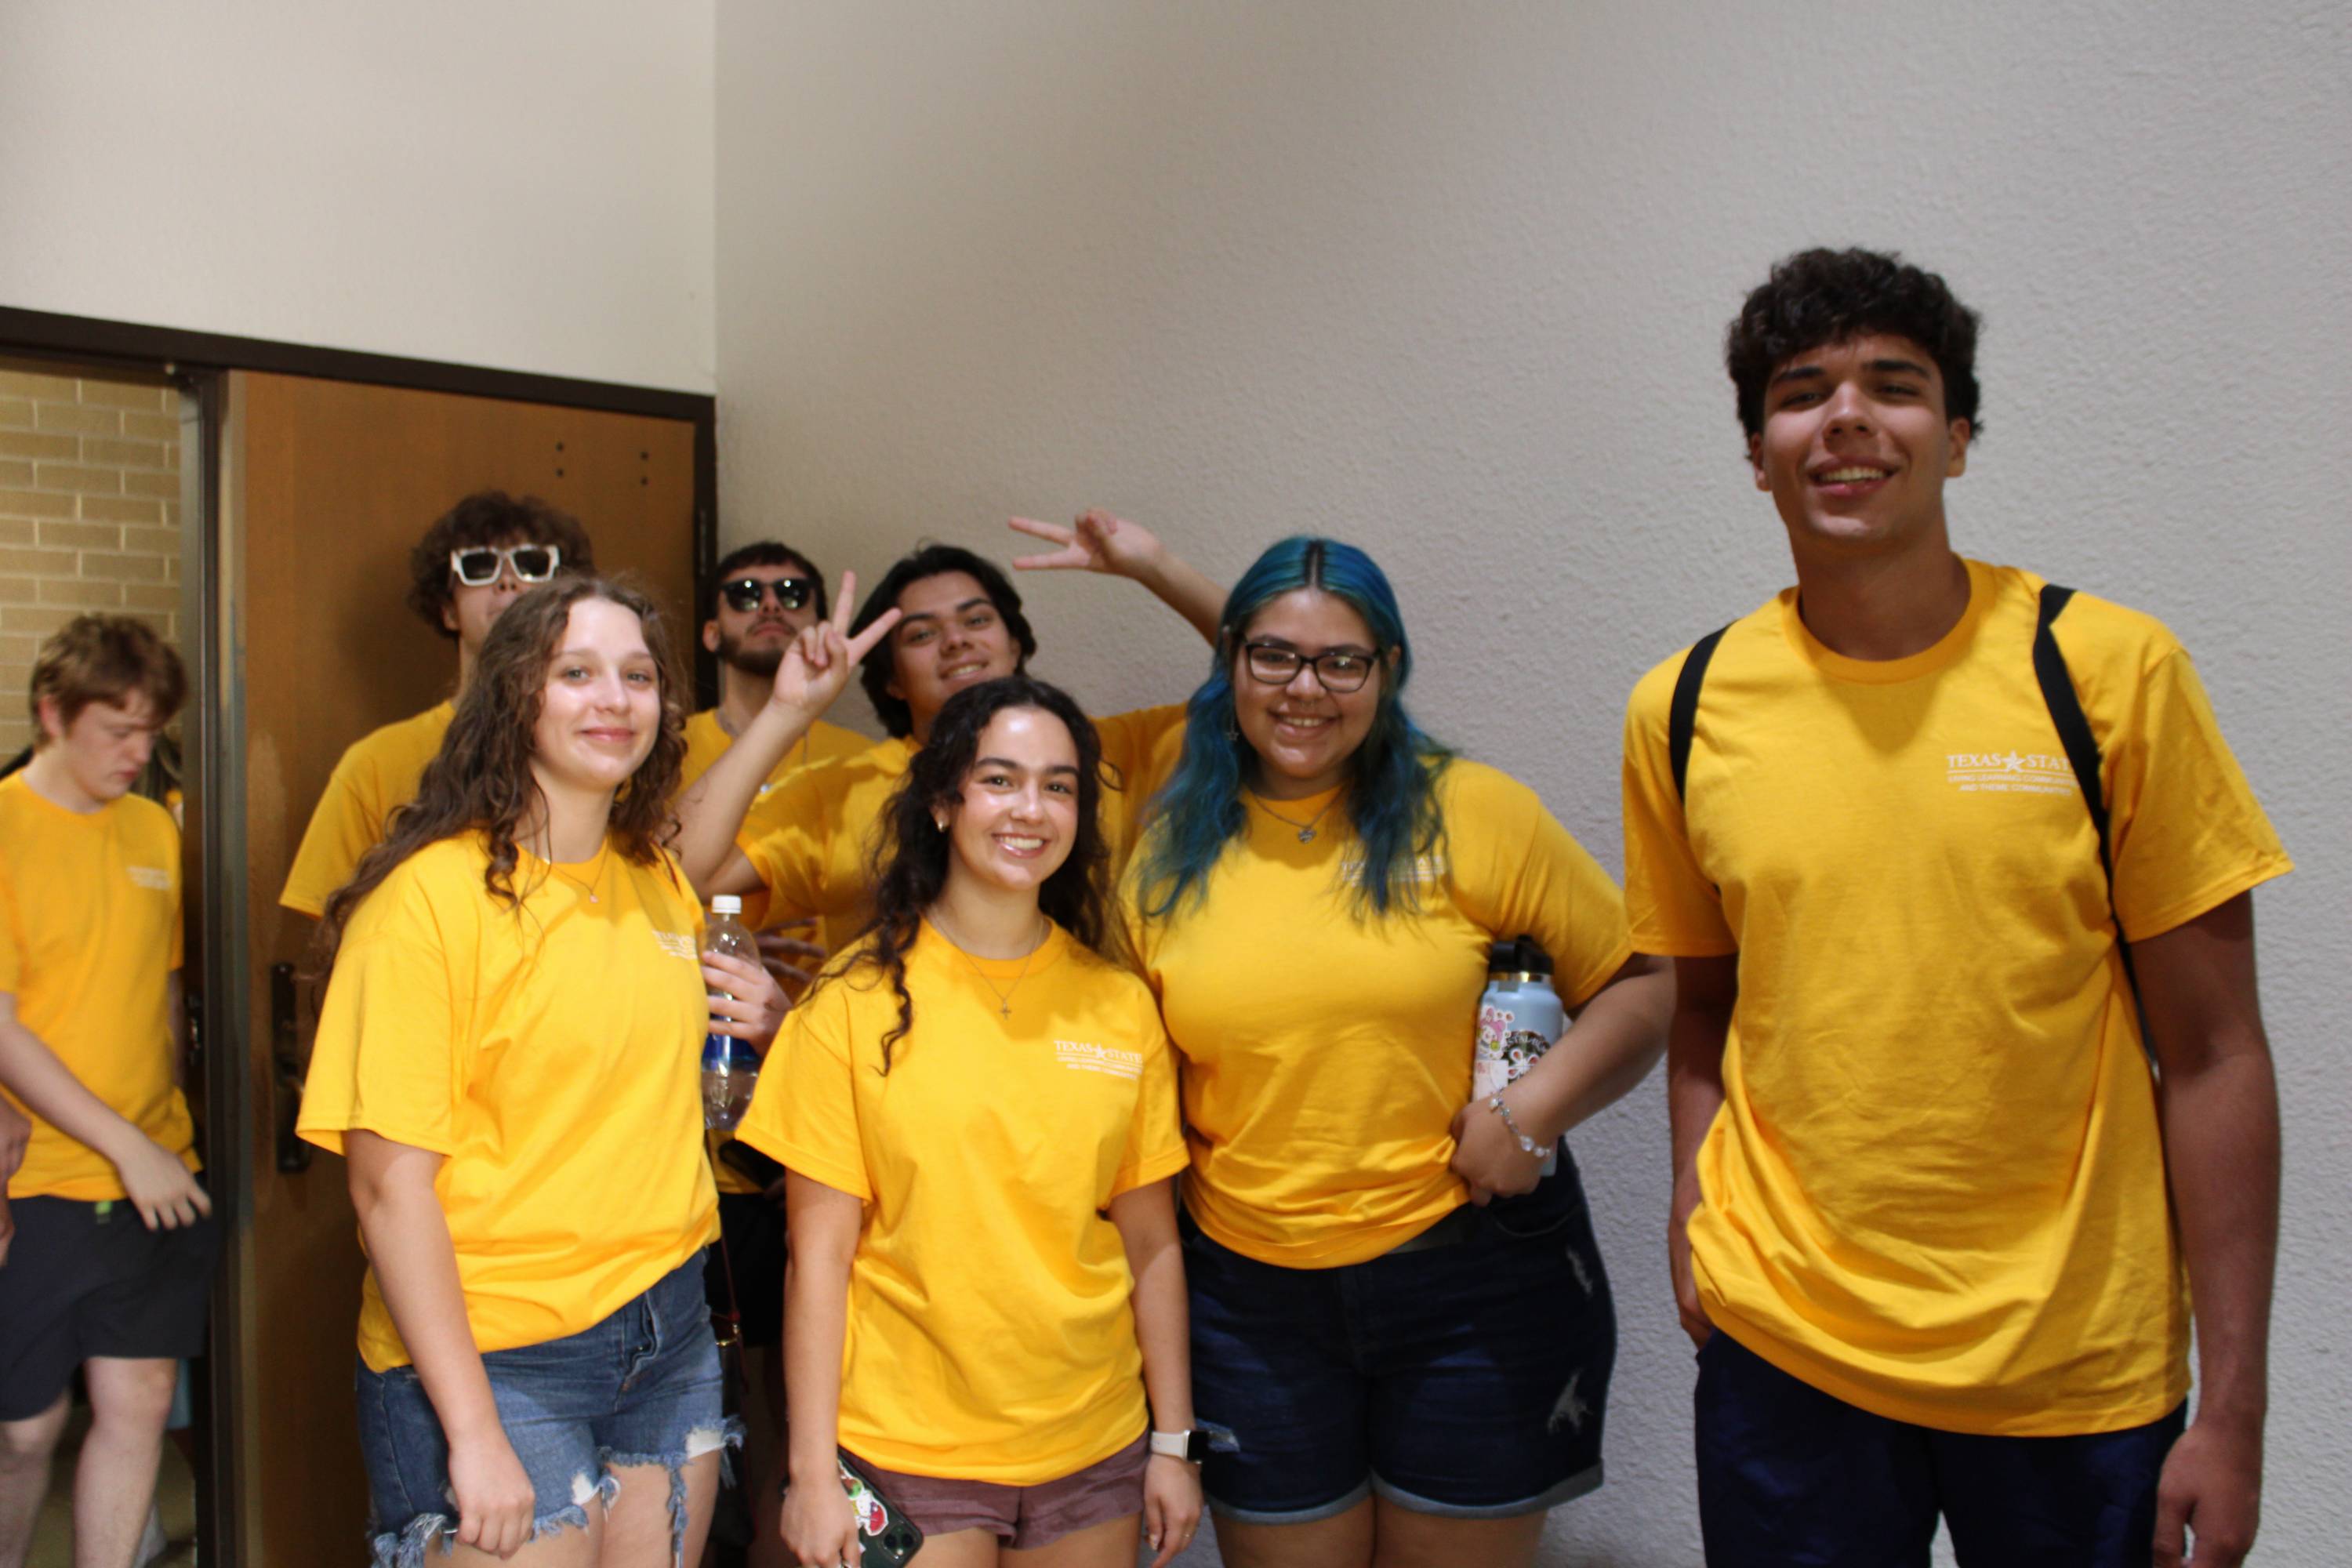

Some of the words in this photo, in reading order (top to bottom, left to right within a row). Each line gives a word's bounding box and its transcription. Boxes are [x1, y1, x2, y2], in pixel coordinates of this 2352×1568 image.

[1946, 753, 2002, 768] TEXAS
[2026, 753, 2071, 771] STAT
[1054, 1040, 1092, 1053] TEXAS
[1107, 1049, 1142, 1063] STATE
